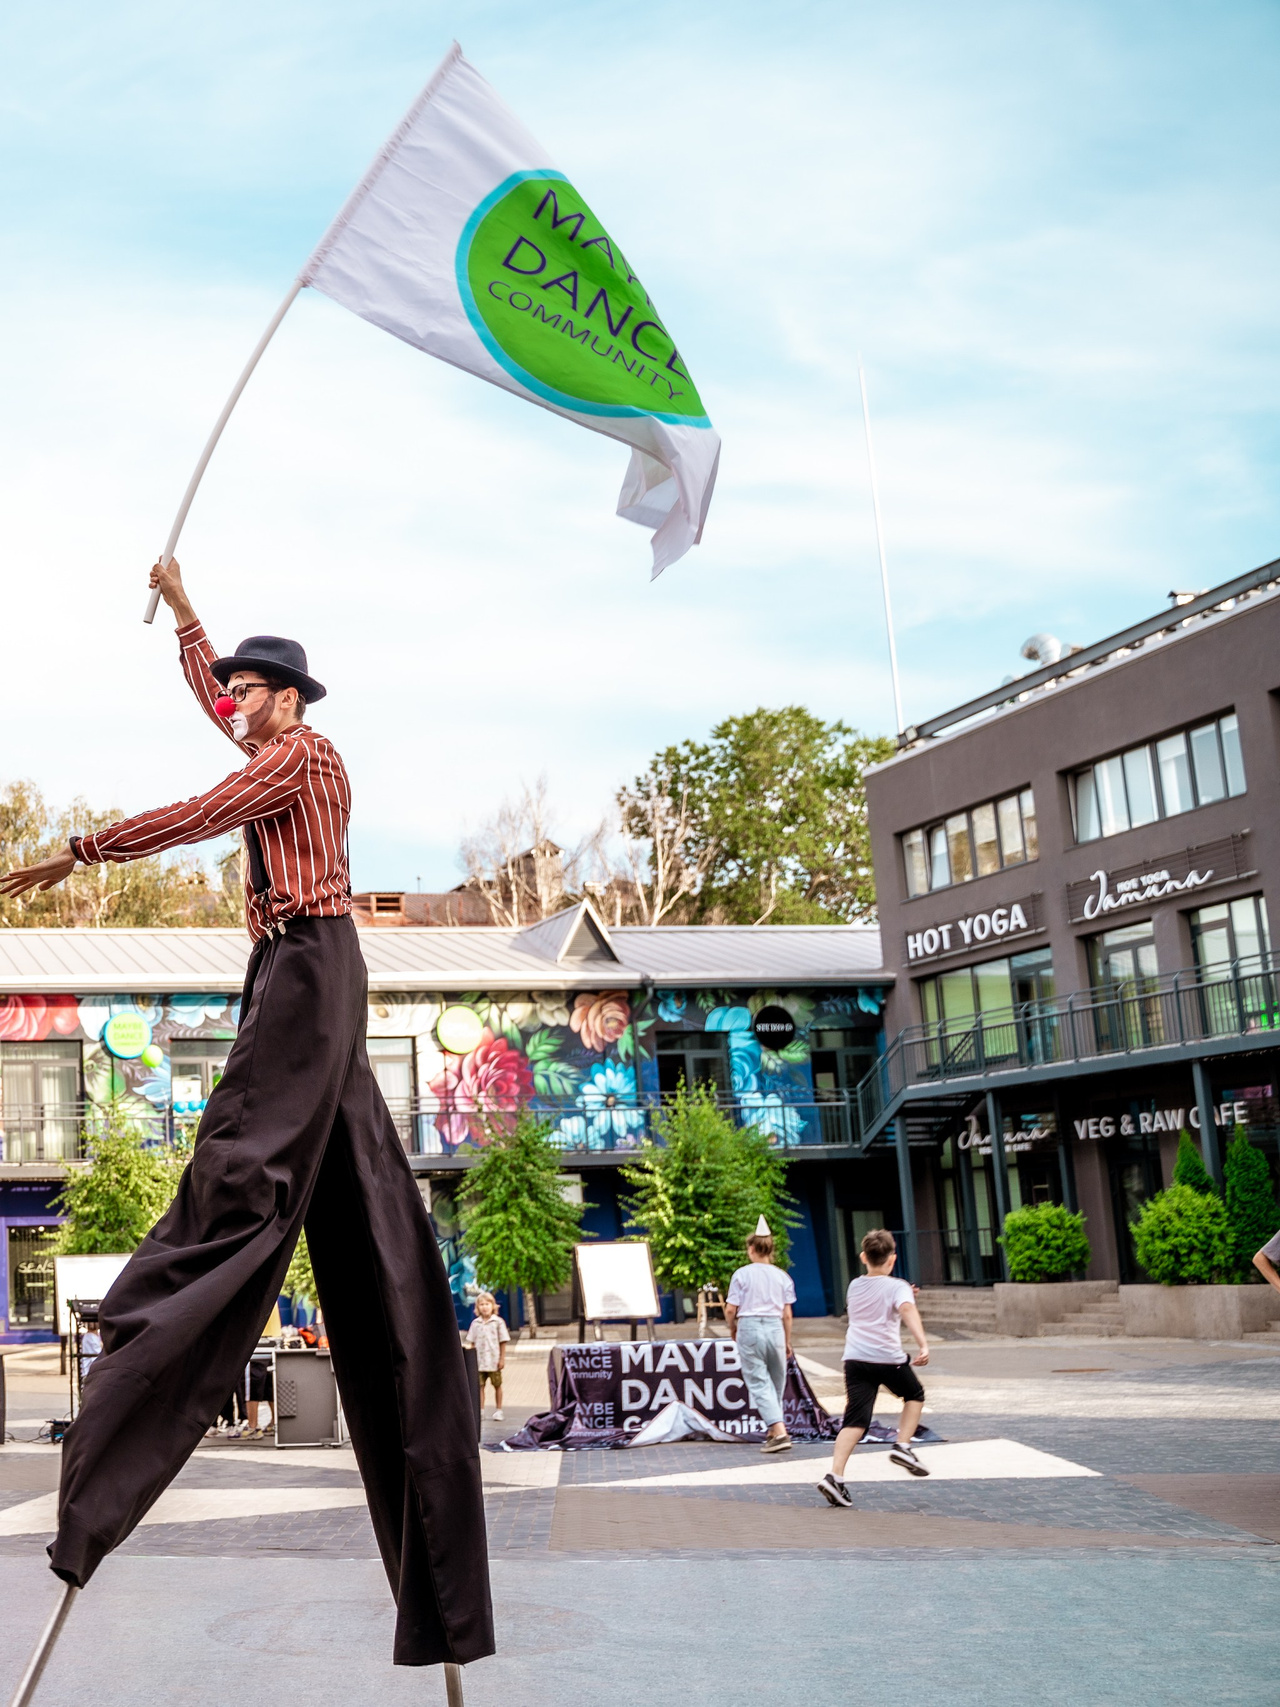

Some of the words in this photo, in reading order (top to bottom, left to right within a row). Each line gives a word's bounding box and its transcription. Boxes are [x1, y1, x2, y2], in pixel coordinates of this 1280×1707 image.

[488, 280, 683, 400] COMMUNITY
[907, 923, 953, 959] HOT
[957, 903, 1029, 944] YOGA
[1073, 1115, 1116, 1140] VEG
[1120, 1113, 1135, 1136] &
[1138, 1107, 1185, 1134] RAW
[567, 1355, 613, 1369] ANCE
[620, 1341, 742, 1374] MAYB
[574, 1402, 615, 1415] AYBE
